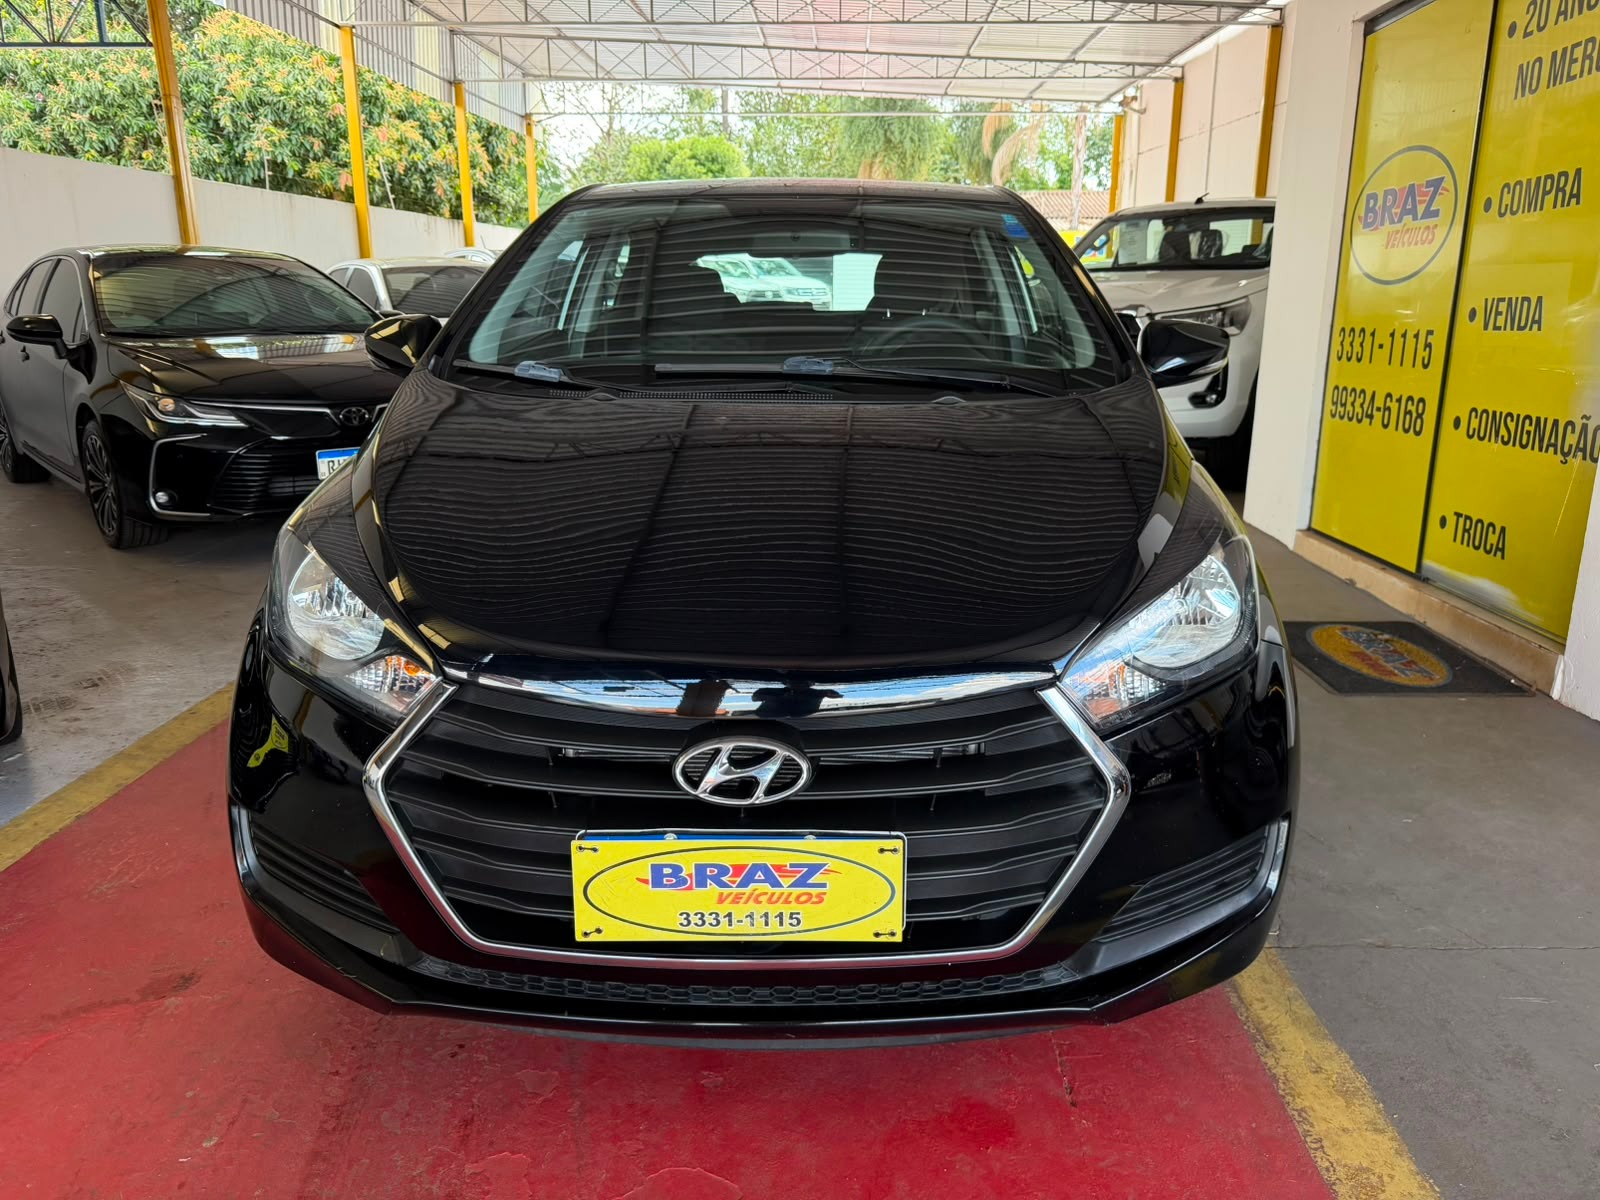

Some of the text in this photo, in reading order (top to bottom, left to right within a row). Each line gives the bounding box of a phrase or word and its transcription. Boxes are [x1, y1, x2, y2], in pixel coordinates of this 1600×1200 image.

[1523, 0, 1550, 39] 20
[1514, 56, 1543, 100] NO
[1362, 176, 1445, 230] BRAZ
[1498, 167, 1582, 218] COMPRA
[1385, 223, 1438, 249] VEÍCULOS
[1483, 295, 1543, 331] VENDA
[1336, 327, 1434, 370] 3331-1115
[1330, 384, 1426, 437] 99334-6168
[1453, 511, 1506, 560] TROCA
[649, 862, 829, 890] BRAZ
[716, 889, 828, 906] VEÍCULOS
[678, 911, 802, 928] 3331-1115
